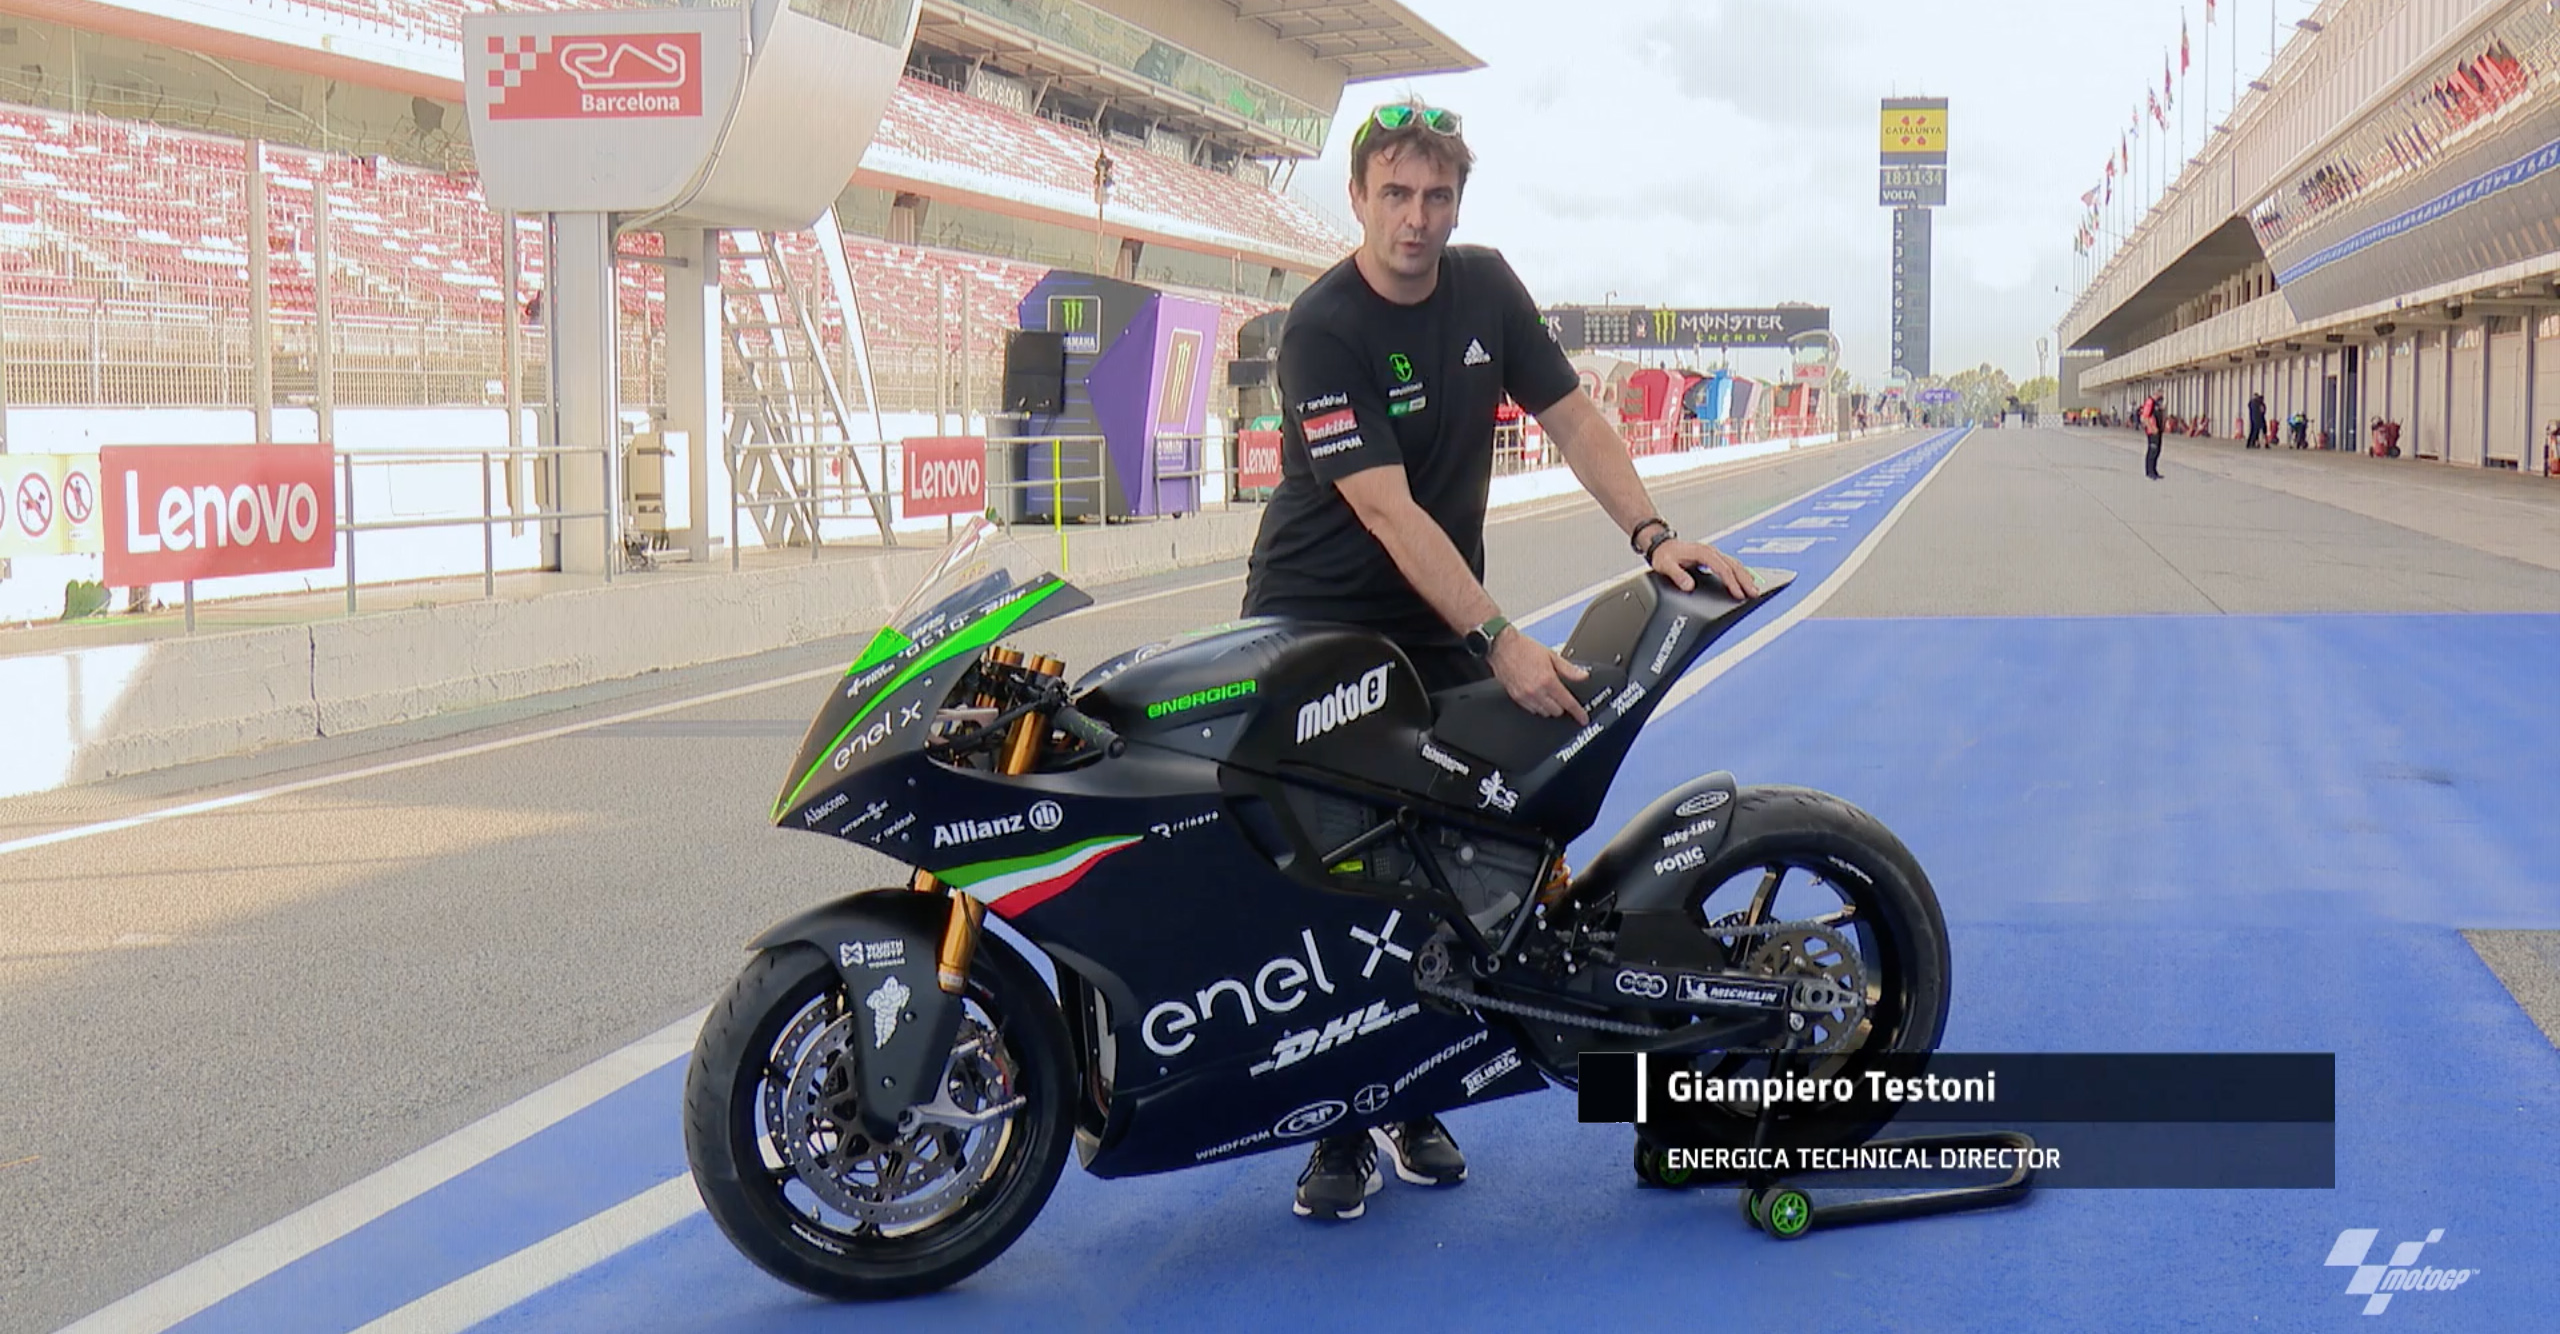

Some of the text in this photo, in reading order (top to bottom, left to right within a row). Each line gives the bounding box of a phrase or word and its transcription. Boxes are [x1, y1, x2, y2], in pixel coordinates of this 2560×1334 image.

[581, 92, 681, 113] Barcelona
[1885, 126, 1942, 135] CATALUNYA
[1882, 190, 1917, 200] VOLTA
[1895, 212, 1903, 223] 1
[1895, 229, 1903, 240] 2
[1895, 246, 1903, 258] 3
[1895, 263, 1903, 275] 4
[1895, 280, 1903, 292] 5
[1895, 297, 1903, 309] 6
[1680, 313, 1785, 333] MONSTER
[1895, 314, 1903, 326] 7
[1895, 331, 1903, 342] 8
[1895, 348, 1903, 359] 9
[1242, 441, 1278, 475] Lenovo
[910, 451, 981, 500] Lenovo
[126, 469, 319, 554] Lenovo
[834, 711, 893, 772] enel
[933, 811, 1025, 849] Allianz
[1142, 927, 1336, 1056] enel
[1709, 987, 1778, 1003] MICHELIN
[1272, 999, 1397, 1072] DHL
[1195, 1129, 1271, 1161] WINDFORM
